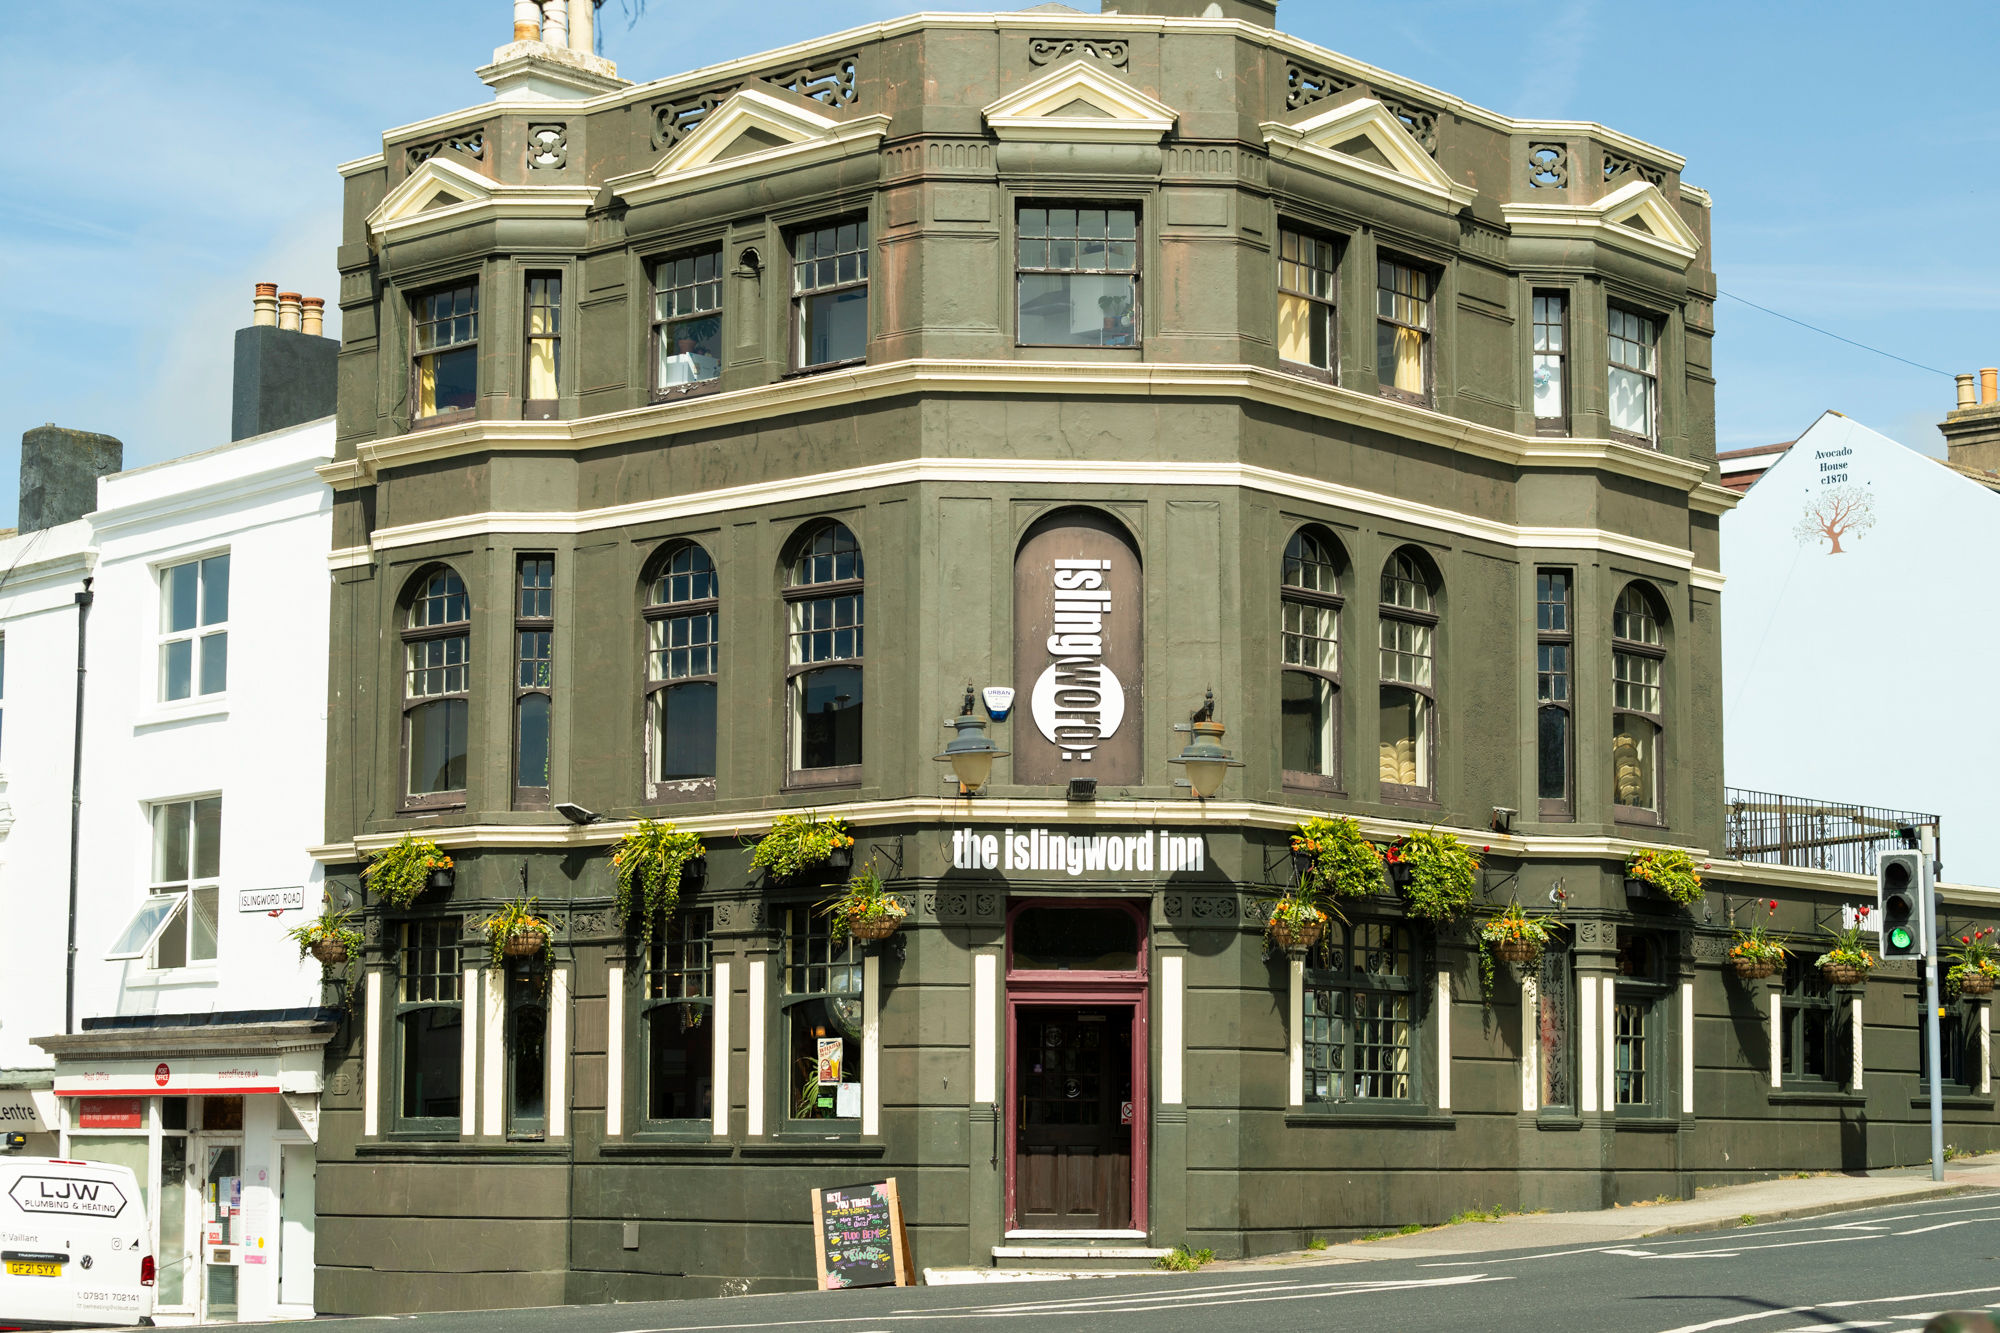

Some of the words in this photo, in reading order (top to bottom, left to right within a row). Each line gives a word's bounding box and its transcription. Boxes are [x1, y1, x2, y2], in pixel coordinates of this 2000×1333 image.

[1815, 446, 1853, 460] Avocado
[1820, 462, 1848, 472] House
[1821, 473, 1848, 484] c1870
[1047, 559, 1111, 750] islingword
[953, 828, 998, 869] the
[1005, 828, 1154, 876] islingword
[1160, 830, 1205, 872] inn
[241, 894, 280, 907] ISLINGWORD
[283, 892, 301, 904] ROAD
[219, 1068, 259, 1080] postoffice.co.uk
[0, 1103, 36, 1120] entre
[40, 1181, 99, 1201] LJW
[25, 1200, 69, 1209] PLUMBING
[72, 1202, 79, 1210] &
[82, 1203, 116, 1213] HEATING
[836, 1200, 849, 1209] YOU
[9, 1233, 38, 1243] Vaillant
[12, 1263, 35, 1274] GF21
[36, 1264, 56, 1275] SYX
